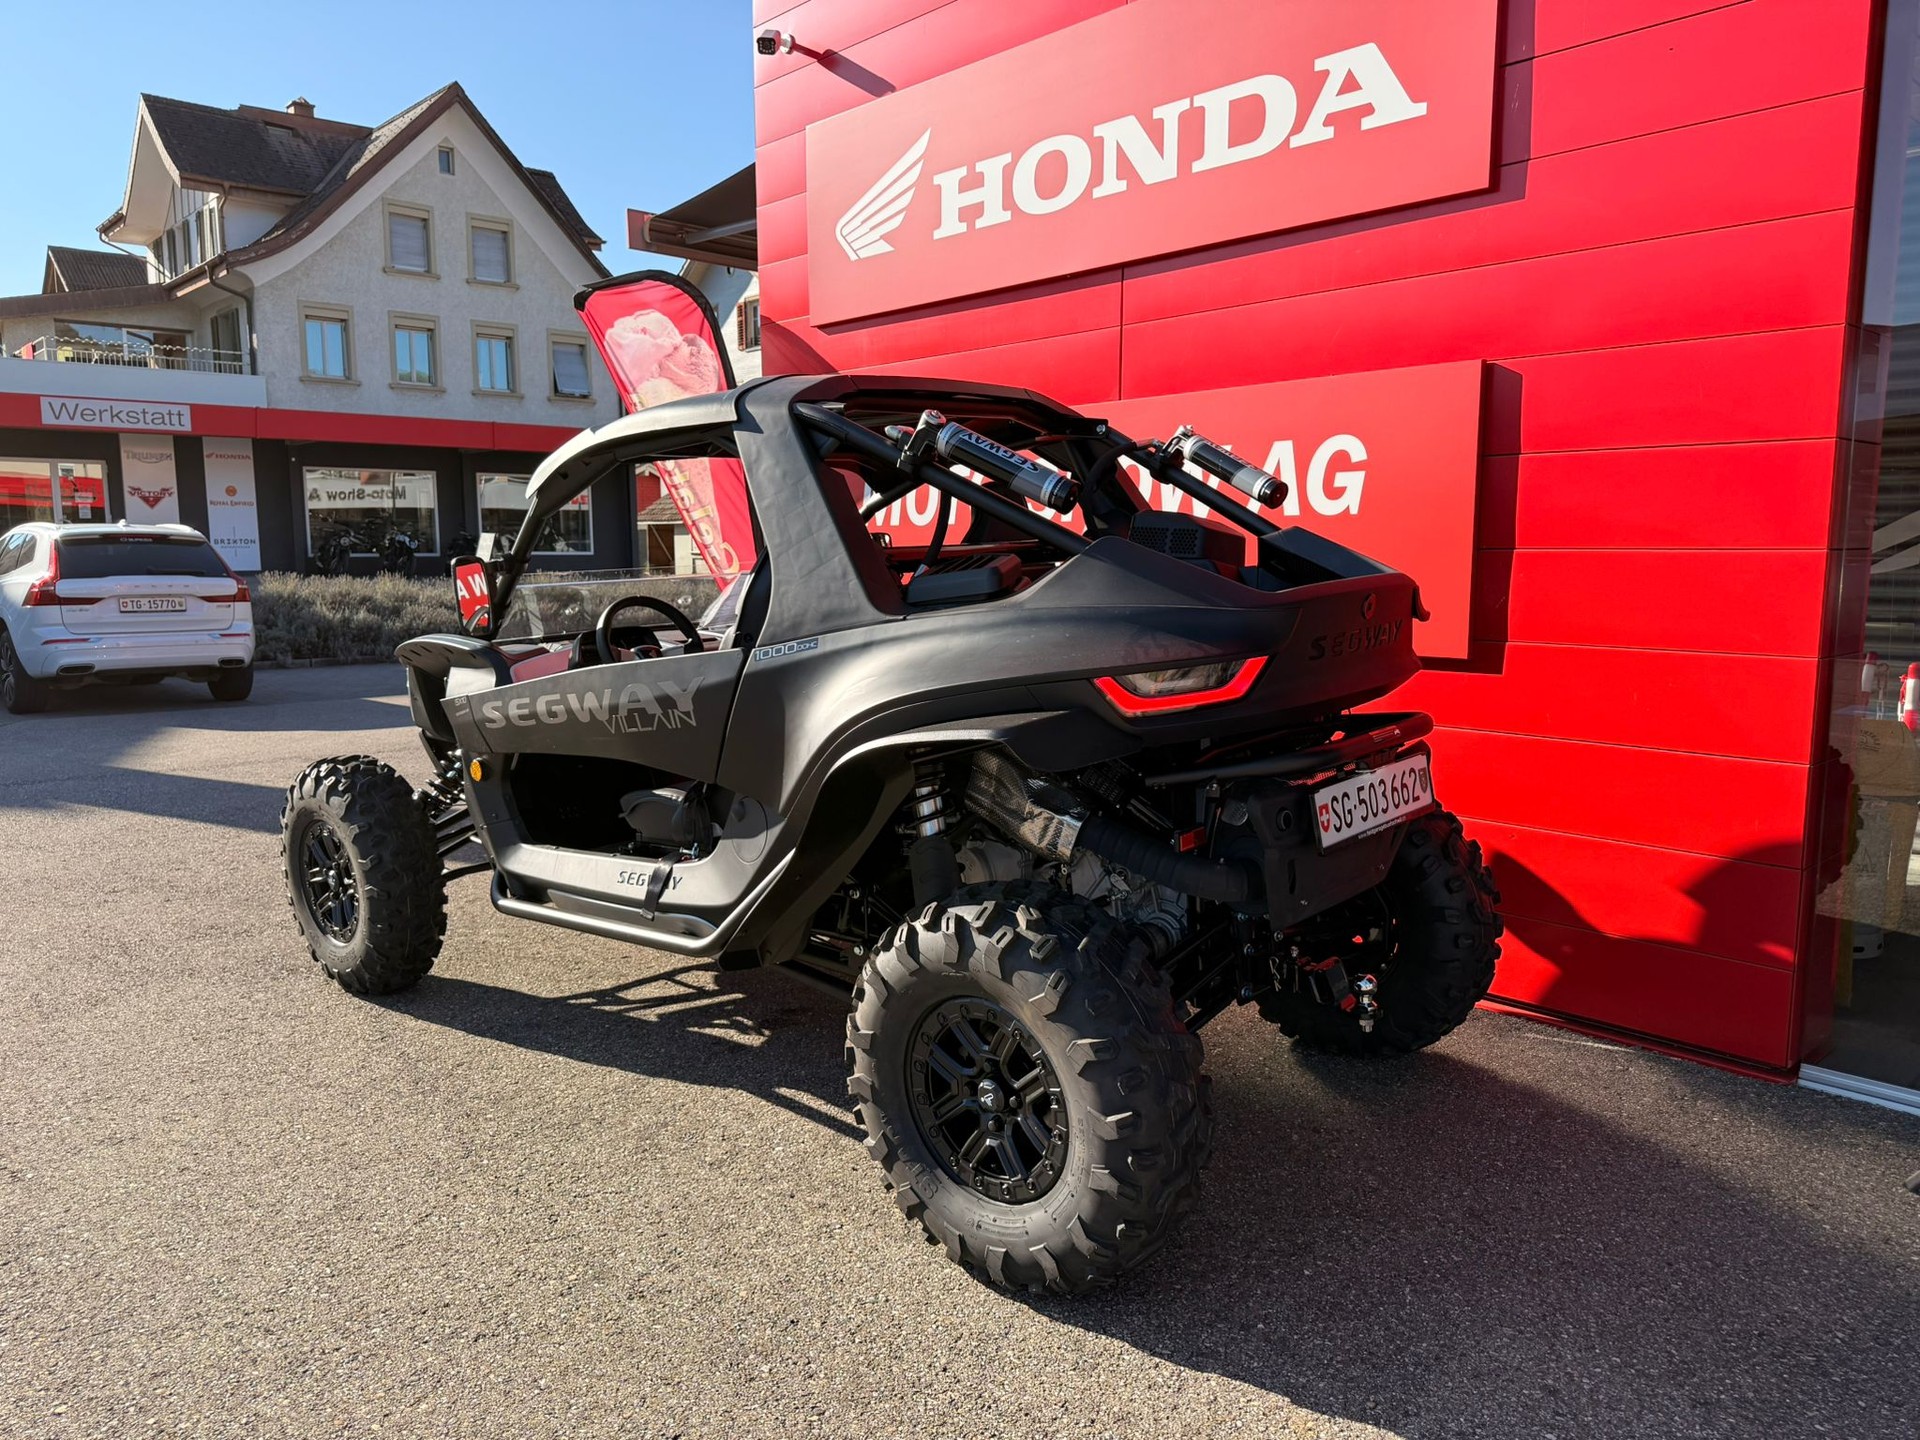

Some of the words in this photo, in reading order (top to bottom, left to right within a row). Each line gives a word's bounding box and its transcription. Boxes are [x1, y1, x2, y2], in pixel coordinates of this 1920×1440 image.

[932, 42, 1427, 240] HONDA
[48, 401, 186, 427] Werkstatt
[959, 431, 1041, 474] SEGWAY
[1246, 433, 1368, 518] AG
[128, 488, 175, 498] VICTORY
[213, 538, 257, 546] BRIXTON
[1308, 619, 1403, 661] SEGWAY
[481, 676, 706, 730] SEGWAY
[602, 708, 697, 735] VILLAIN
[616, 870, 684, 891] SEGY
